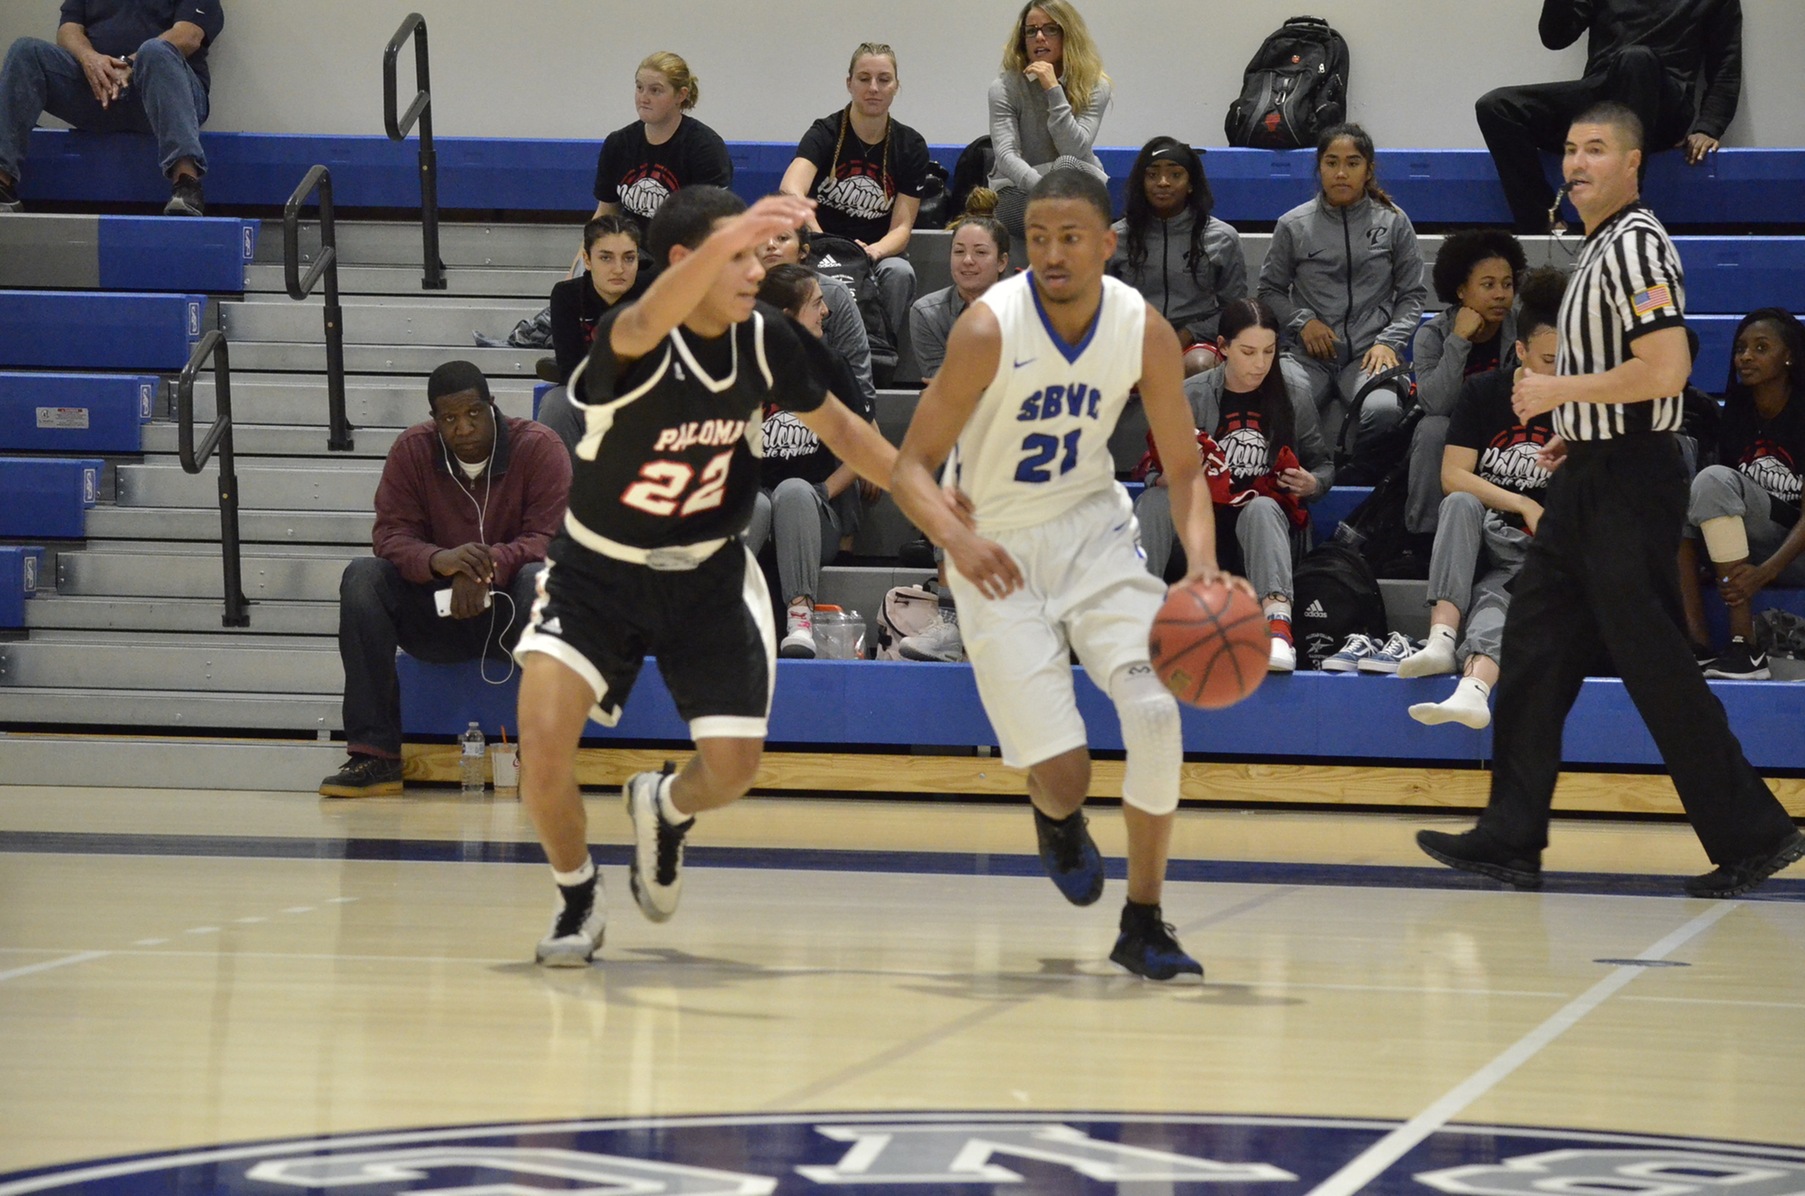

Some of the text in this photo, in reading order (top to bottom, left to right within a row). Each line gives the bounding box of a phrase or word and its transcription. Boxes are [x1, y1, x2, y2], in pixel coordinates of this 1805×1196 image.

[1016, 382, 1102, 422] SBVC
[1013, 427, 1082, 483] 21
[619, 447, 735, 517] 22
[1304, 611, 1328, 619] adidas
